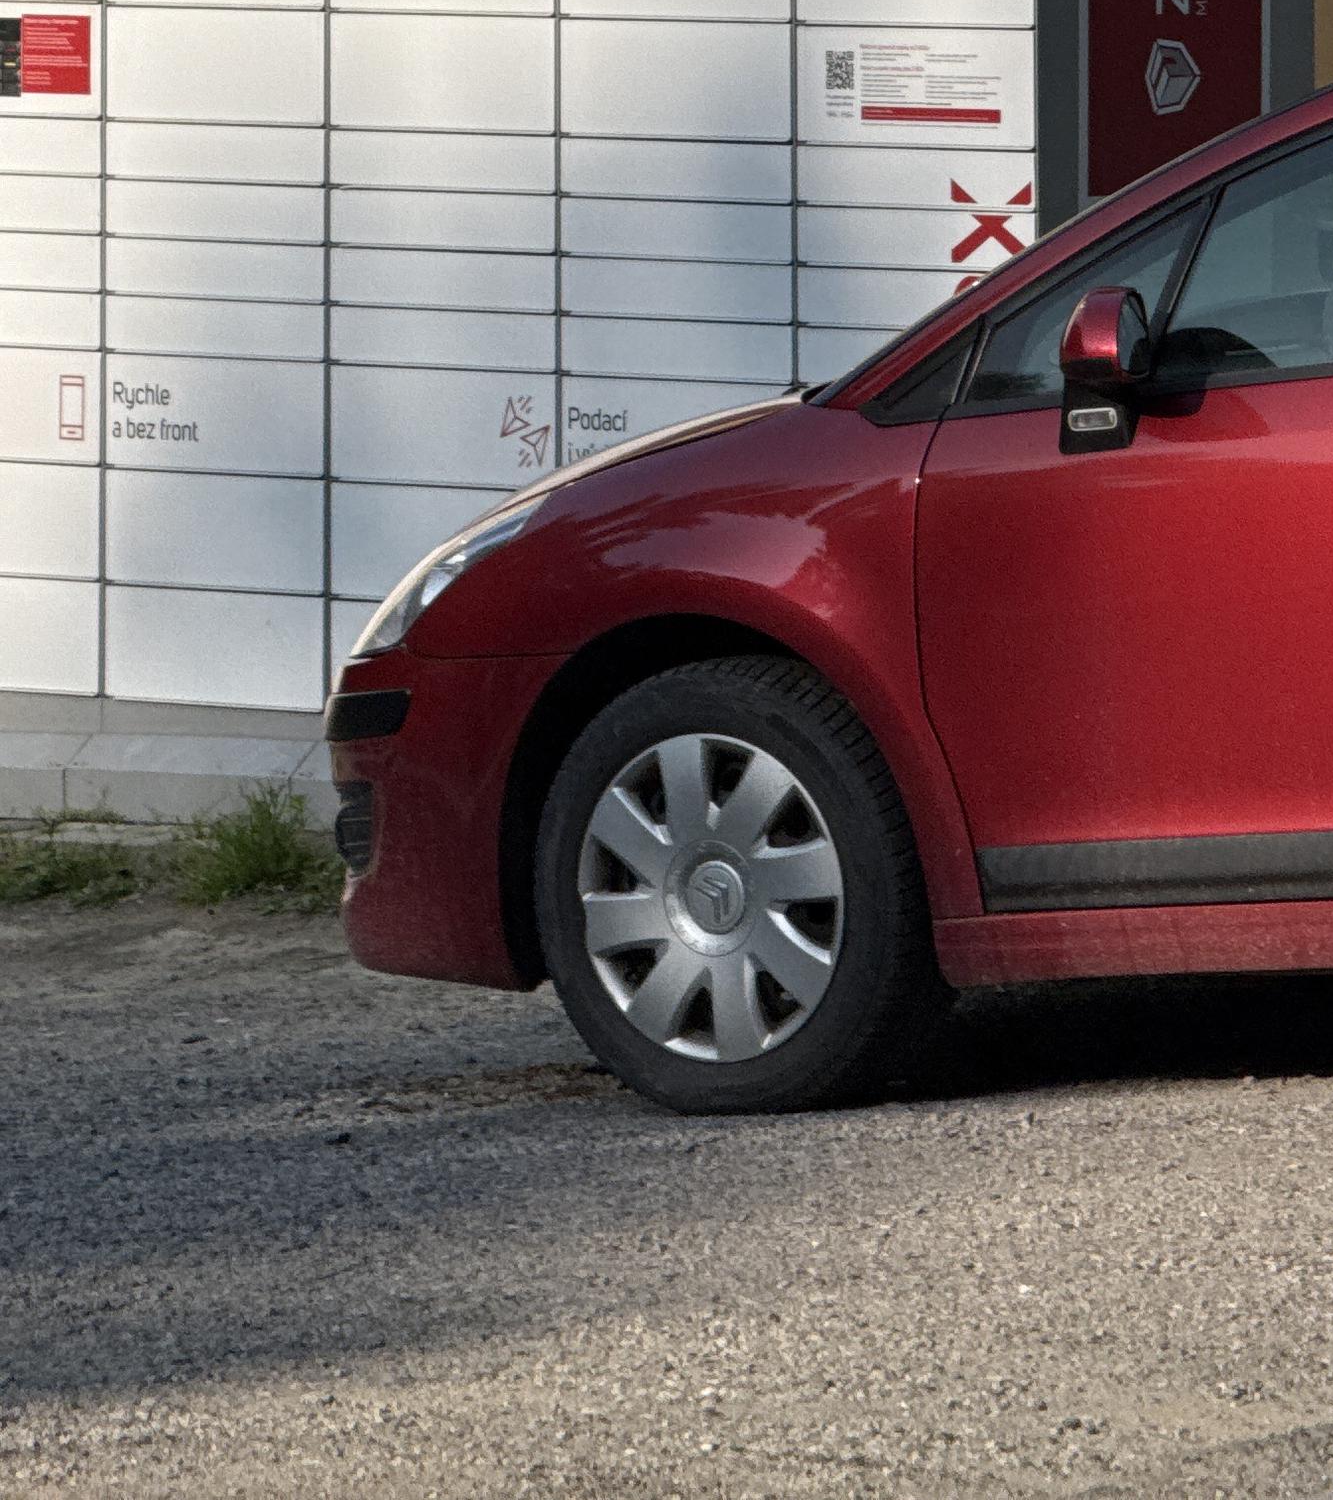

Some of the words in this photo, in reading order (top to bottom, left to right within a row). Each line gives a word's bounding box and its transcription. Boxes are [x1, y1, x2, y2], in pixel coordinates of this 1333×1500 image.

[112, 381, 171, 410] Rychle
[112, 421, 122, 438] a
[126, 417, 156, 439] bez
[160, 418, 200, 442] front
[568, 406, 628, 432] Podací
